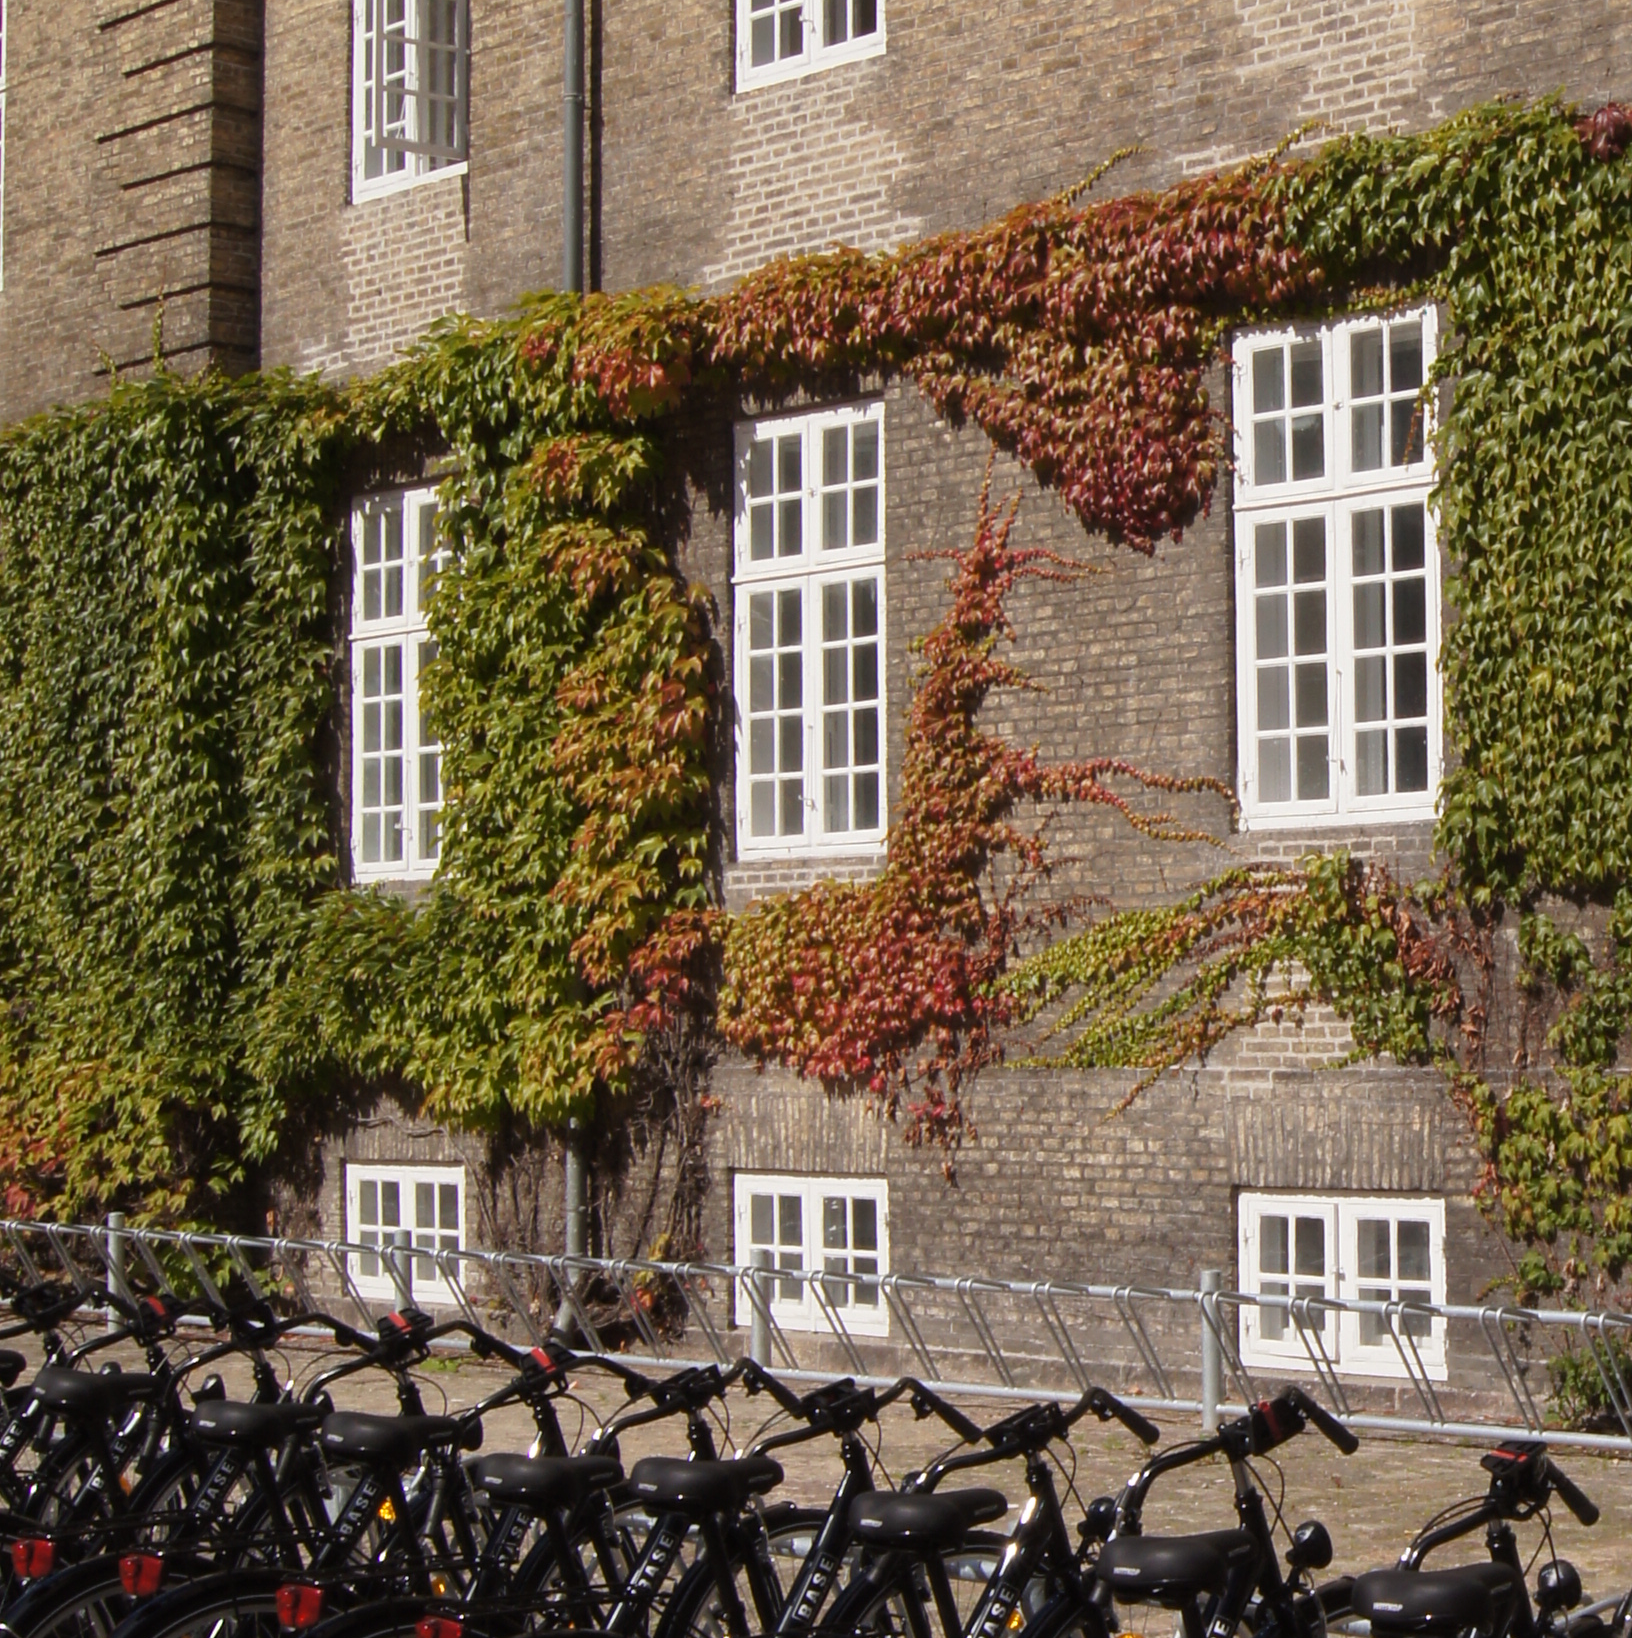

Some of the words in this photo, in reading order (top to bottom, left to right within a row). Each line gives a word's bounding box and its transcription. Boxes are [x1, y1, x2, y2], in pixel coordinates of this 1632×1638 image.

[199, 1461, 235, 1512] BASE
[339, 1483, 377, 1534] BASE
[797, 1557, 835, 1619] BASE
